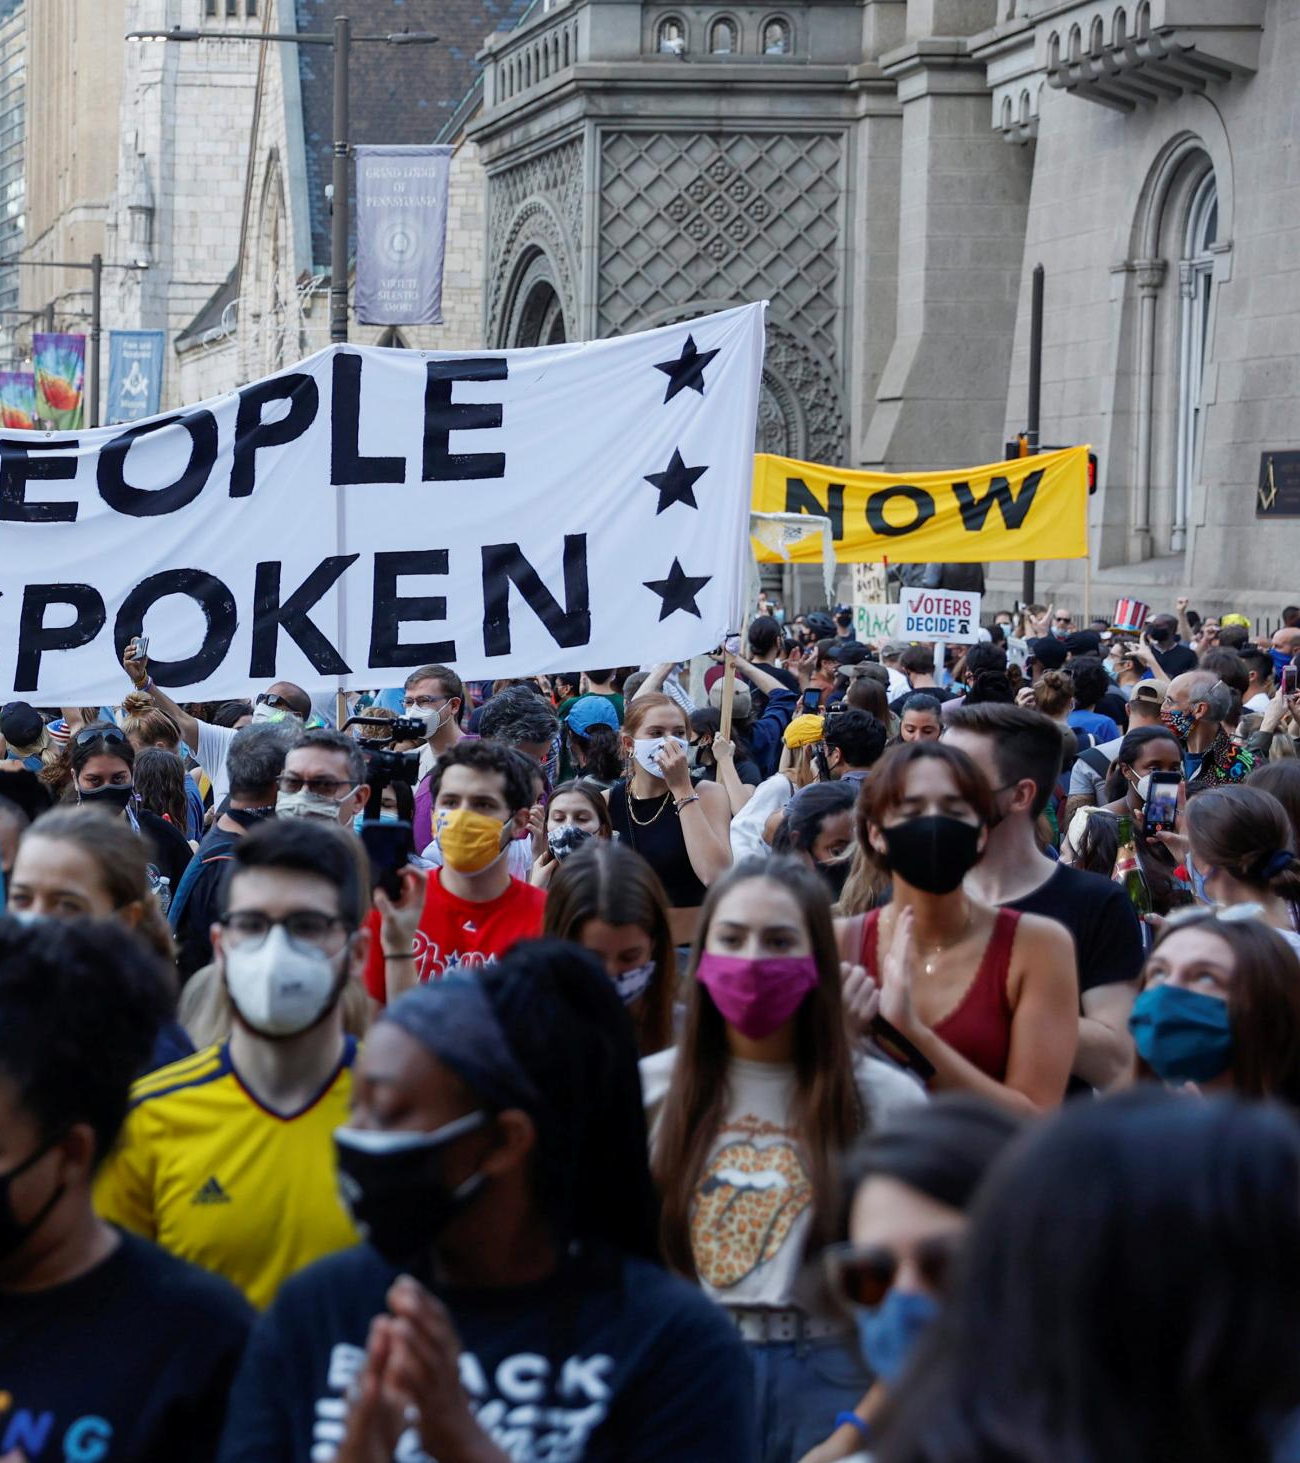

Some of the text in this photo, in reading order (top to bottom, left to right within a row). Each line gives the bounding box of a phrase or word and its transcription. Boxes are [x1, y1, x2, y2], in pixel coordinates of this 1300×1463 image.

[365, 167, 402, 178] GRAND
[393, 182, 407, 193] OF
[786, 468, 1045, 541] NOW
[908, 592, 972, 617] VOTERS
[907, 617, 955, 633] DECIDE
